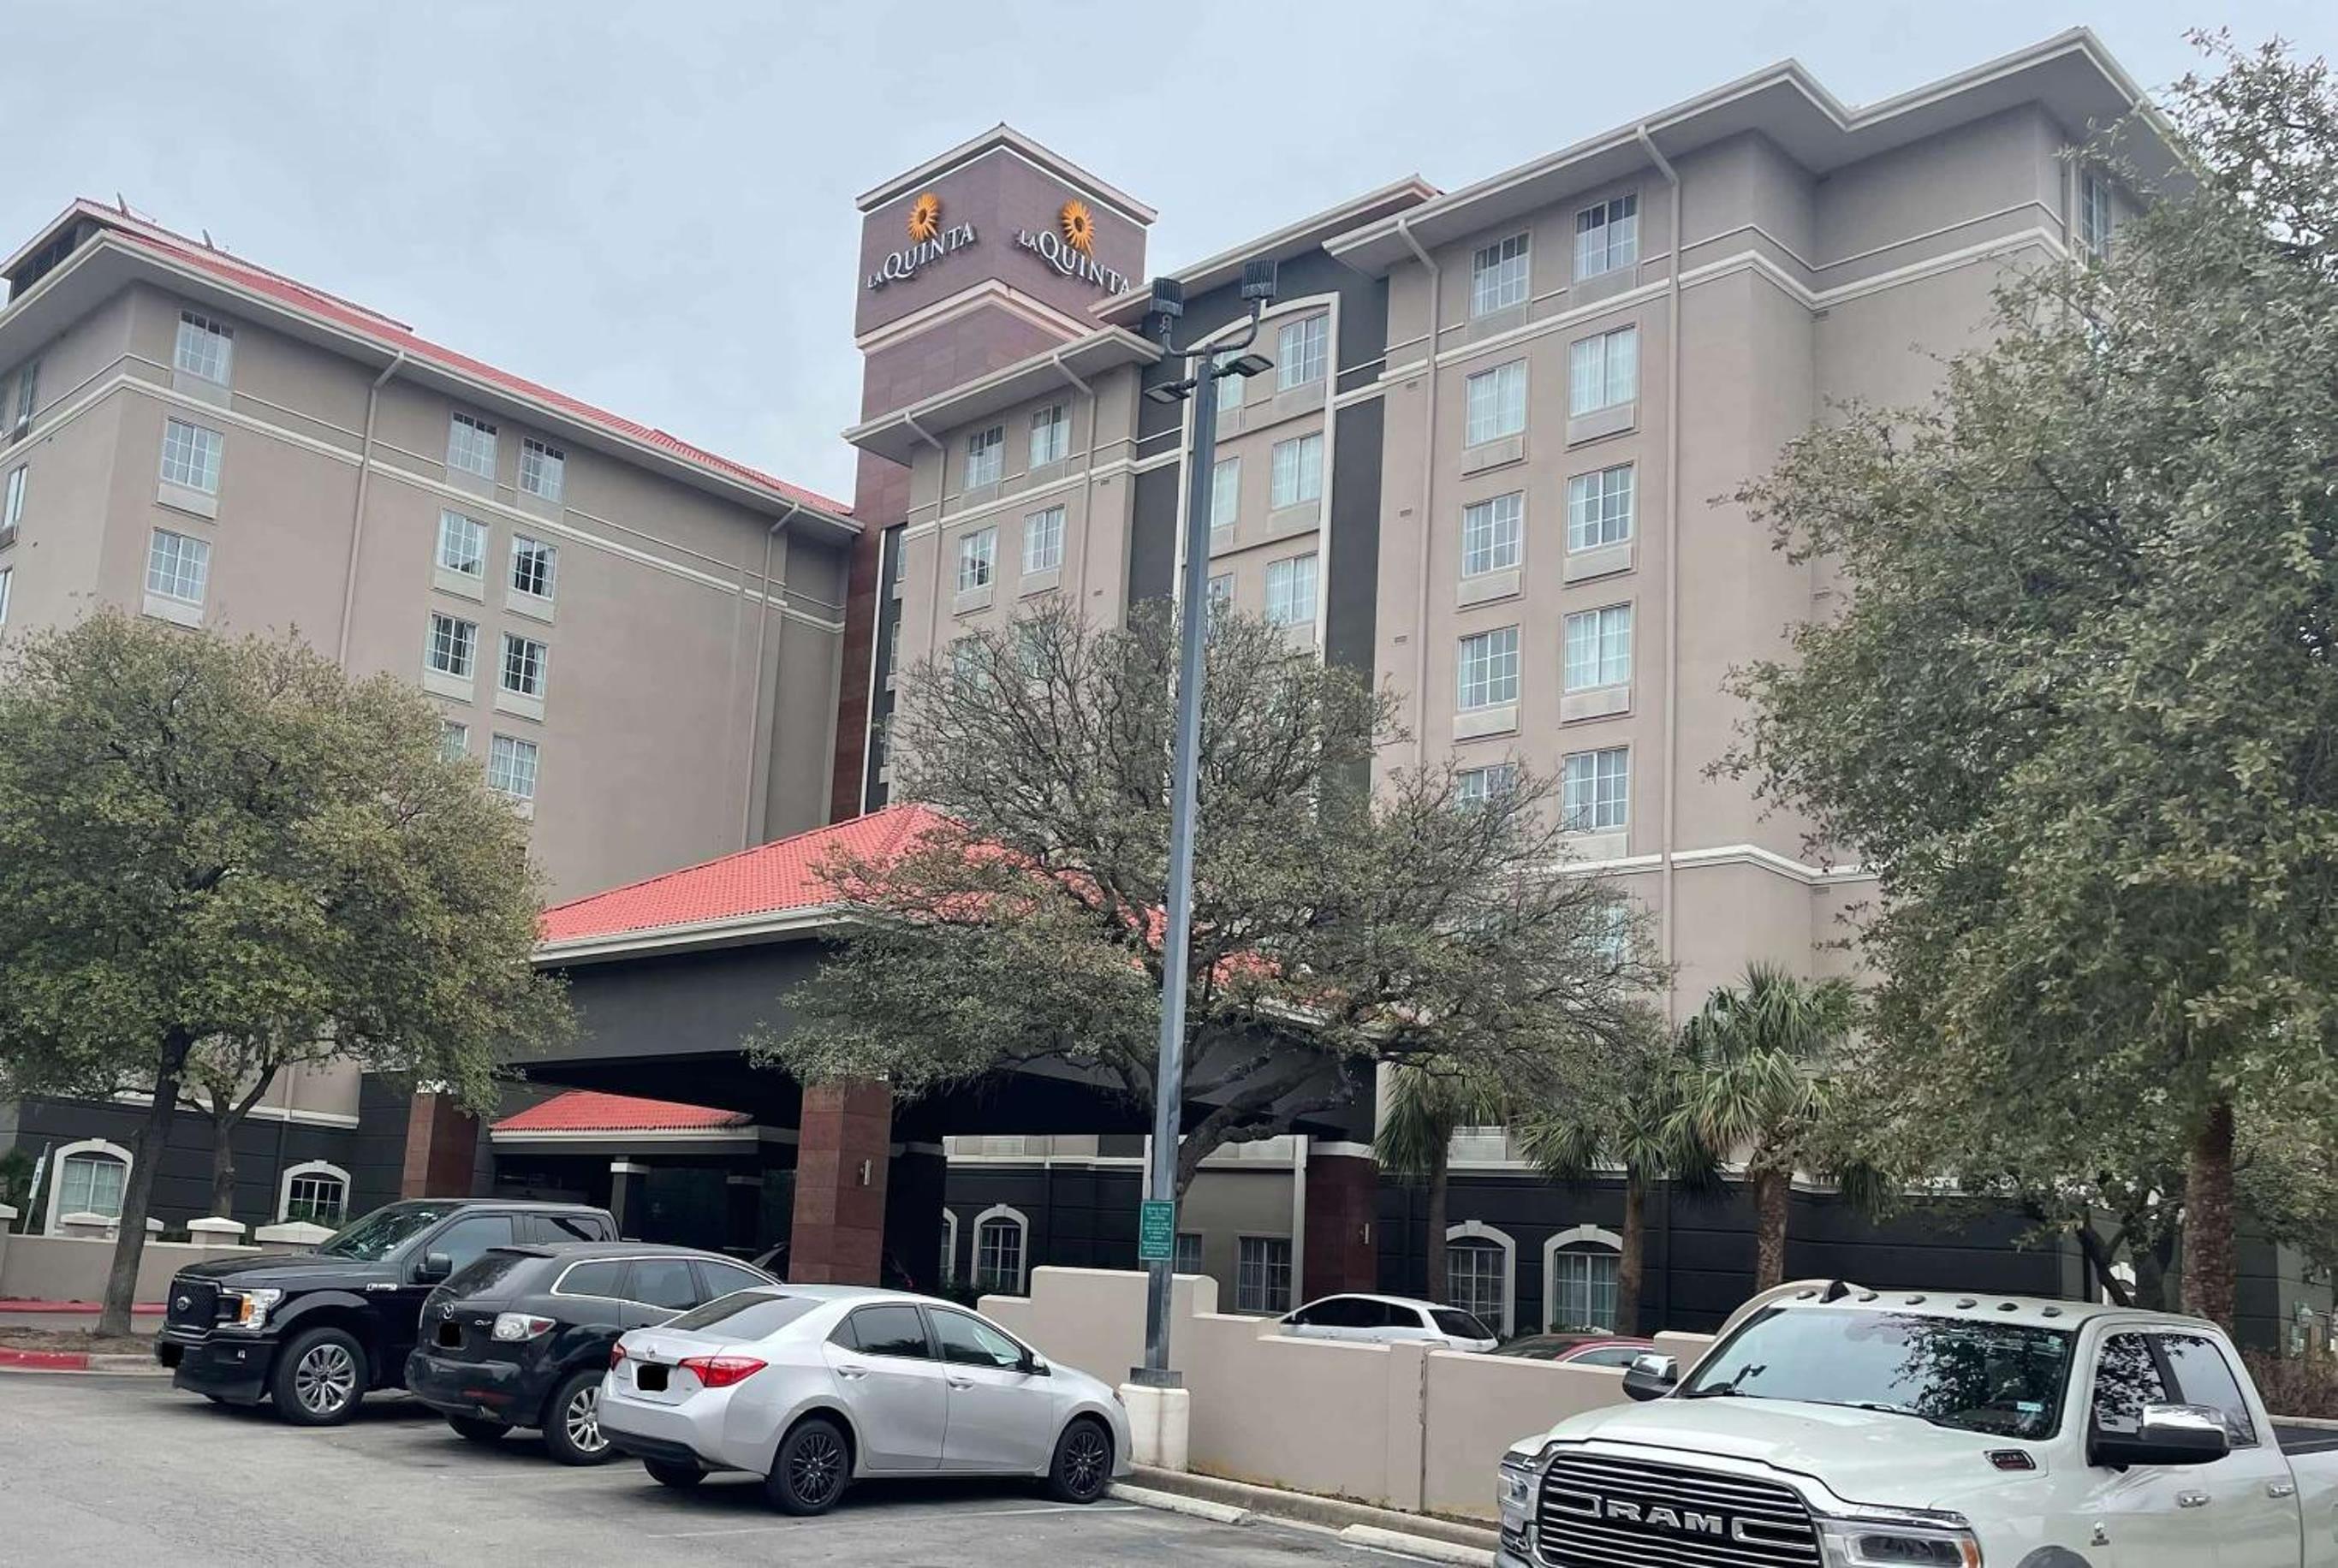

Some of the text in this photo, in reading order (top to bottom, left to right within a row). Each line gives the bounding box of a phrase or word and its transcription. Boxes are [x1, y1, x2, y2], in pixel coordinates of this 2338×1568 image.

[867, 222, 974, 288] LA QUINTA
[1020, 229, 1130, 295] LA QUINTA
[1606, 1499, 1723, 1534] RAM
